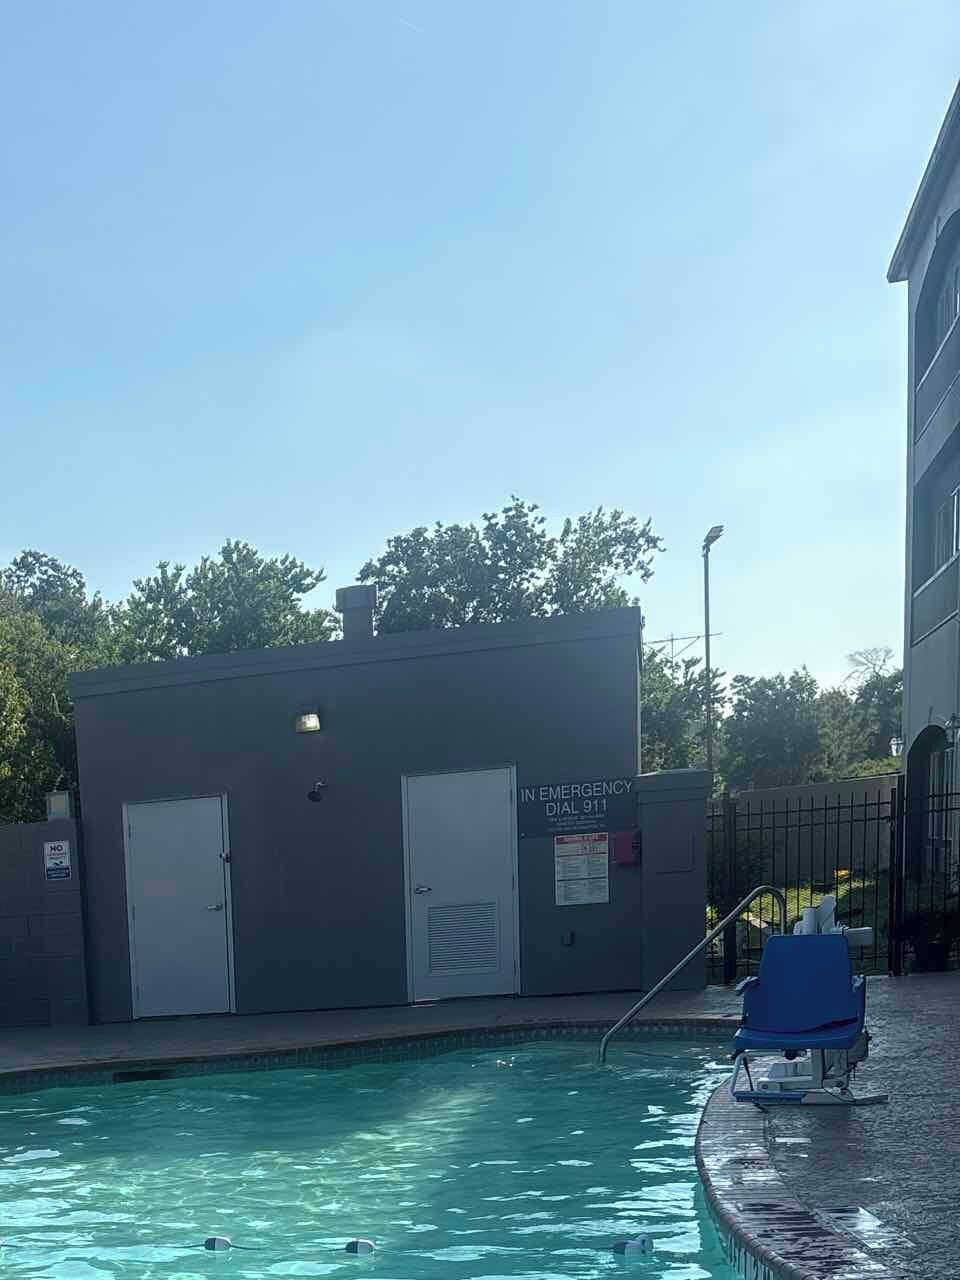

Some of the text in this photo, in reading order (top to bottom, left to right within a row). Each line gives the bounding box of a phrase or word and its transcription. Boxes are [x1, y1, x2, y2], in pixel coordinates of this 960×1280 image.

[520, 780, 632, 802] IN EMERGENCY
[546, 799, 607, 816] DIAL 911
